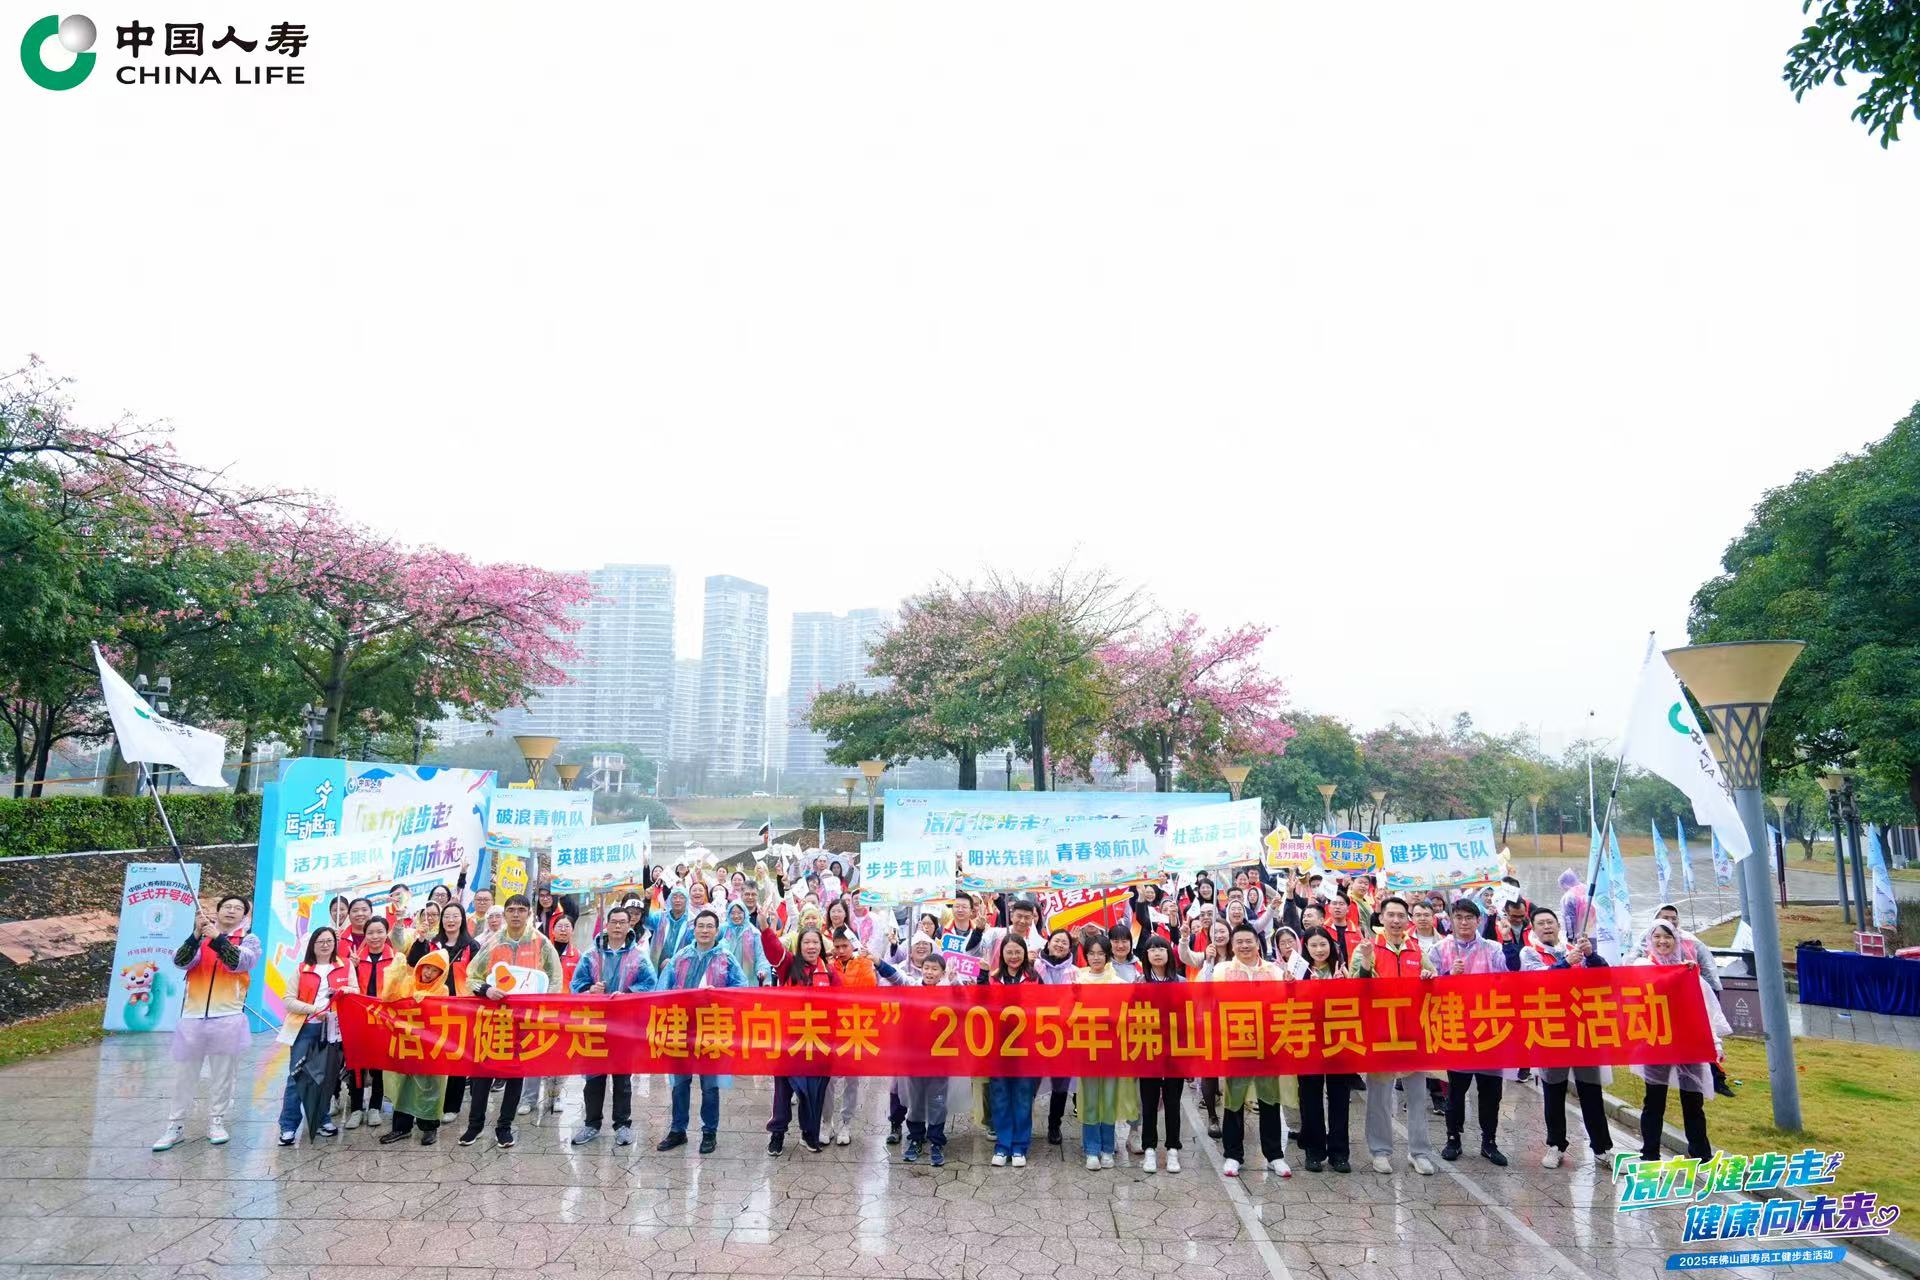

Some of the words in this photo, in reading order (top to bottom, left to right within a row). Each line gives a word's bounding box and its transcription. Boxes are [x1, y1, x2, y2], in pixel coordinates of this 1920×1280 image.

[285, 813, 336, 839] 运动起来
[496, 808, 586, 828] 破浪青帆队
[293, 848, 384, 874] 活力无限队
[392, 837, 459, 880] 康向未来
[557, 843, 637, 867] 英雄联盟队
[968, 849, 1051, 868] 阳光先锋队
[1055, 839, 1151, 863] 青春领航队
[1330, 852, 1375, 864] 丈量活力
[1390, 840, 1488, 864] 健步如飞队
[866, 859, 951, 880] 步步生风队
[367, 1004, 608, 1062] “活力健步走
[646, 1002, 900, 1061] 健康向未来”
[931, 983, 1673, 1061] 2025年佛山国寿员工健步走活动
